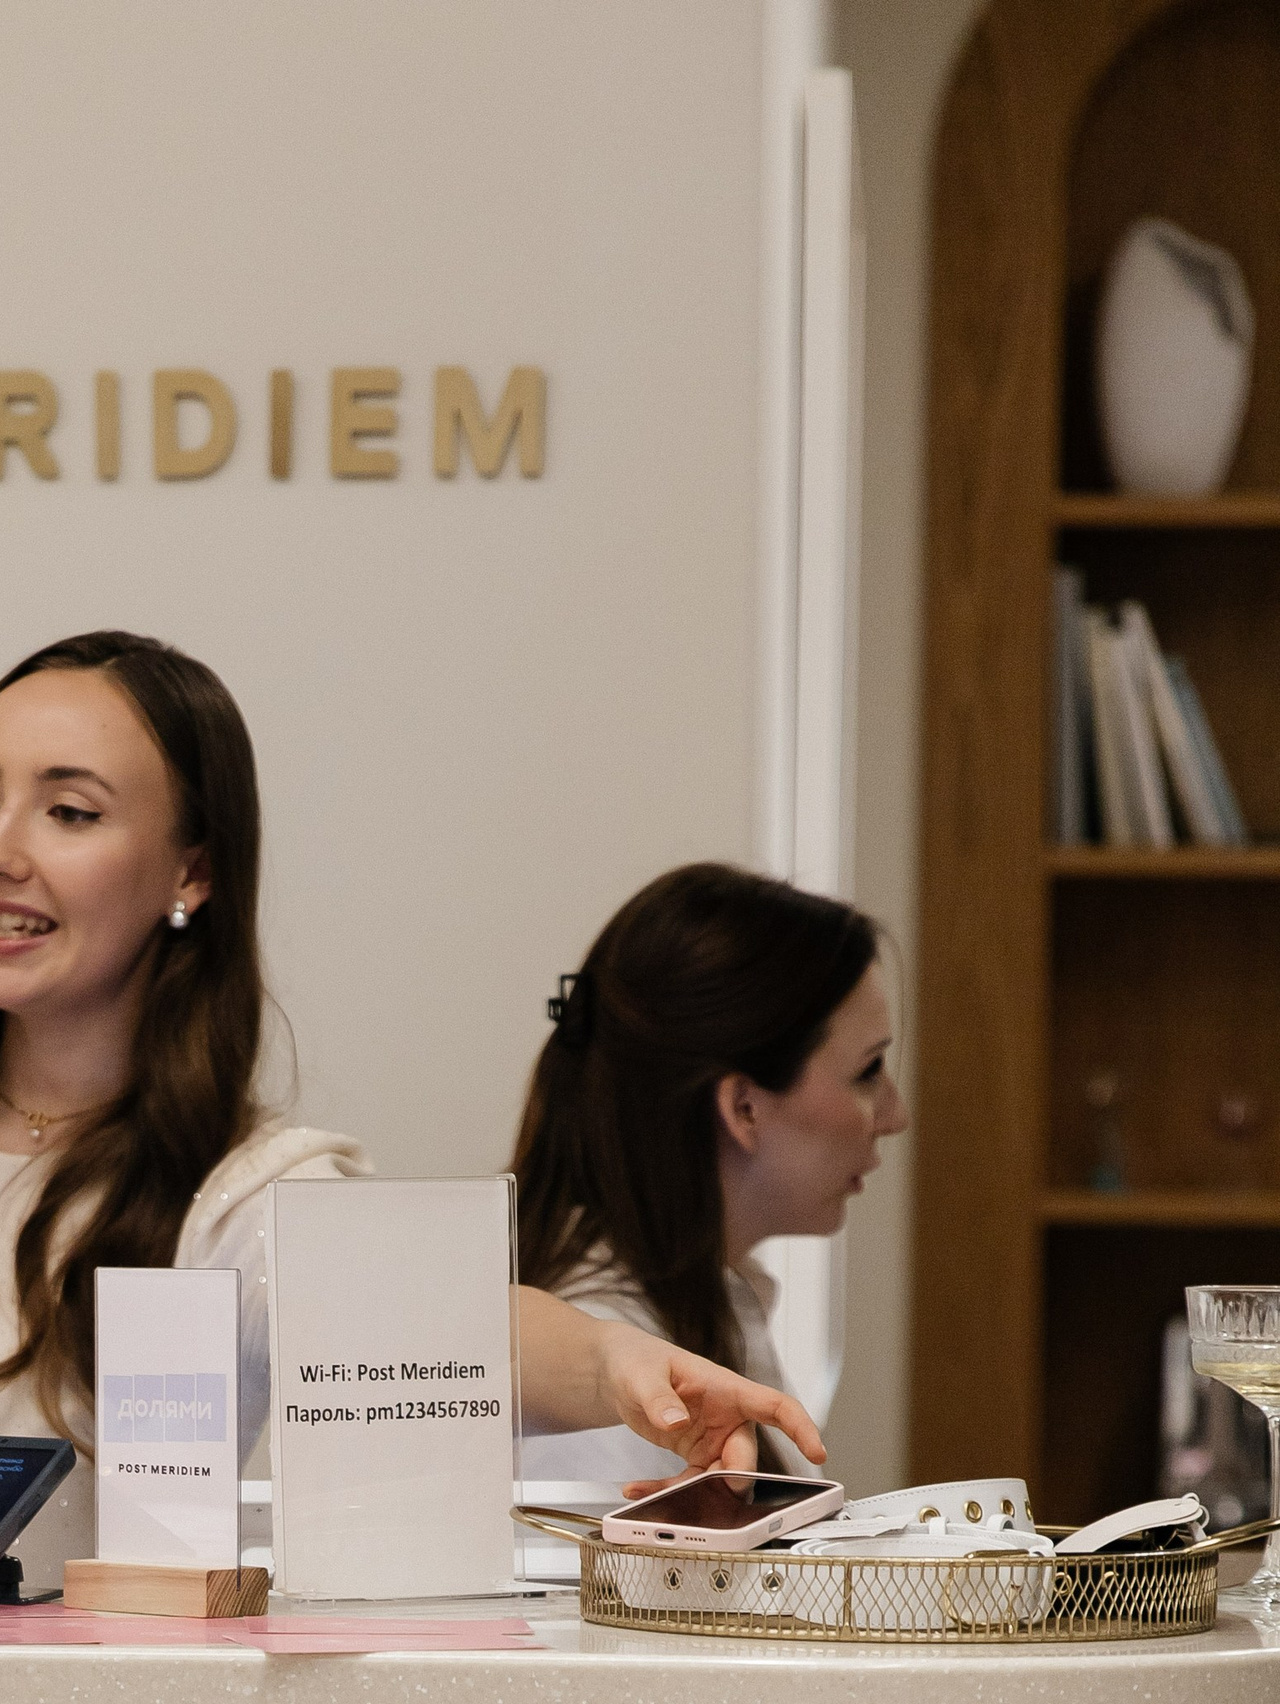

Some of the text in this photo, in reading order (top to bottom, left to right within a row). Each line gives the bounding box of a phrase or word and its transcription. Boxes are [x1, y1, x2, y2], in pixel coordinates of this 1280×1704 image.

[299, 1360, 486, 1383] Wi-Fi: Post Meridiem
[117, 1398, 213, 1421] ДОЛЯМИ
[286, 1399, 501, 1426] Пароль: pm1234567890
[118, 1463, 212, 1477] POST MERIDIEM
